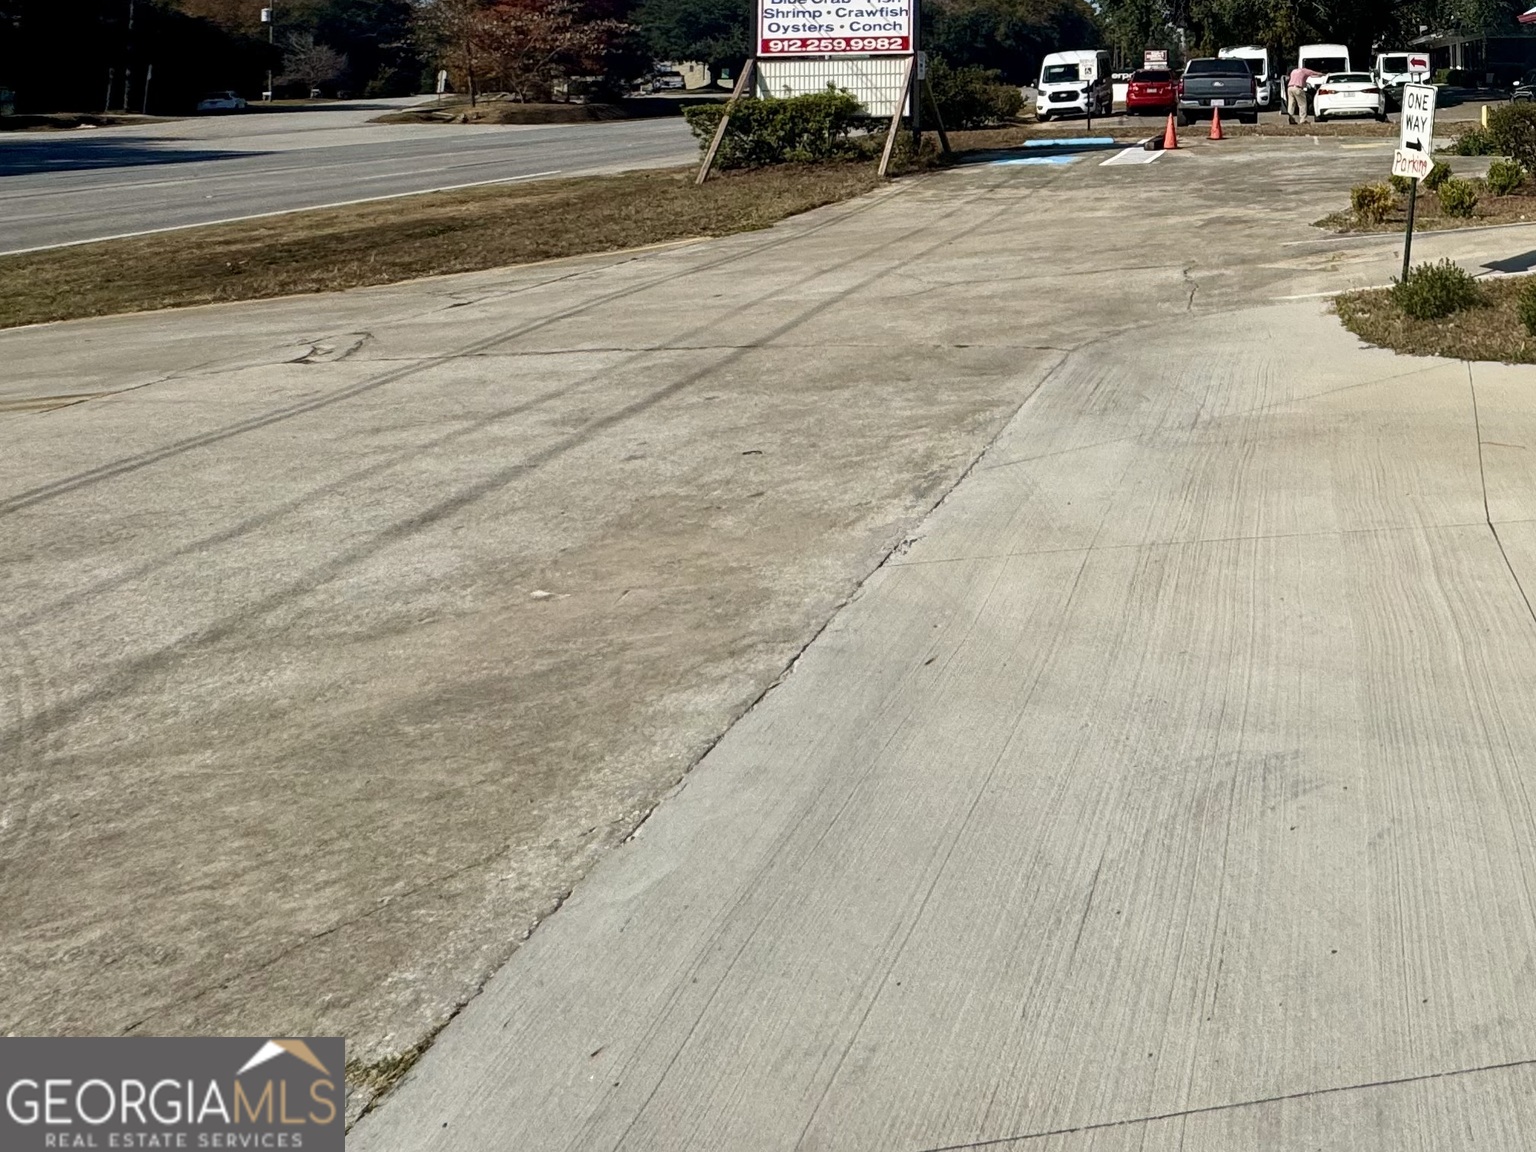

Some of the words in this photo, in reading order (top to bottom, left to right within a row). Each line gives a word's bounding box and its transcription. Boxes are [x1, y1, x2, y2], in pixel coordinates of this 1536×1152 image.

[763, 8, 823, 21] Shrimp
[834, 7, 909, 19] Crawfish
[768, 22, 835, 35] Oysters
[849, 21, 903, 32] Conch
[769, 38, 903, 53] 912.259.9982
[1408, 92, 1429, 111] ONE
[1405, 114, 1429, 133] WAY
[1395, 151, 1428, 178] Parking
